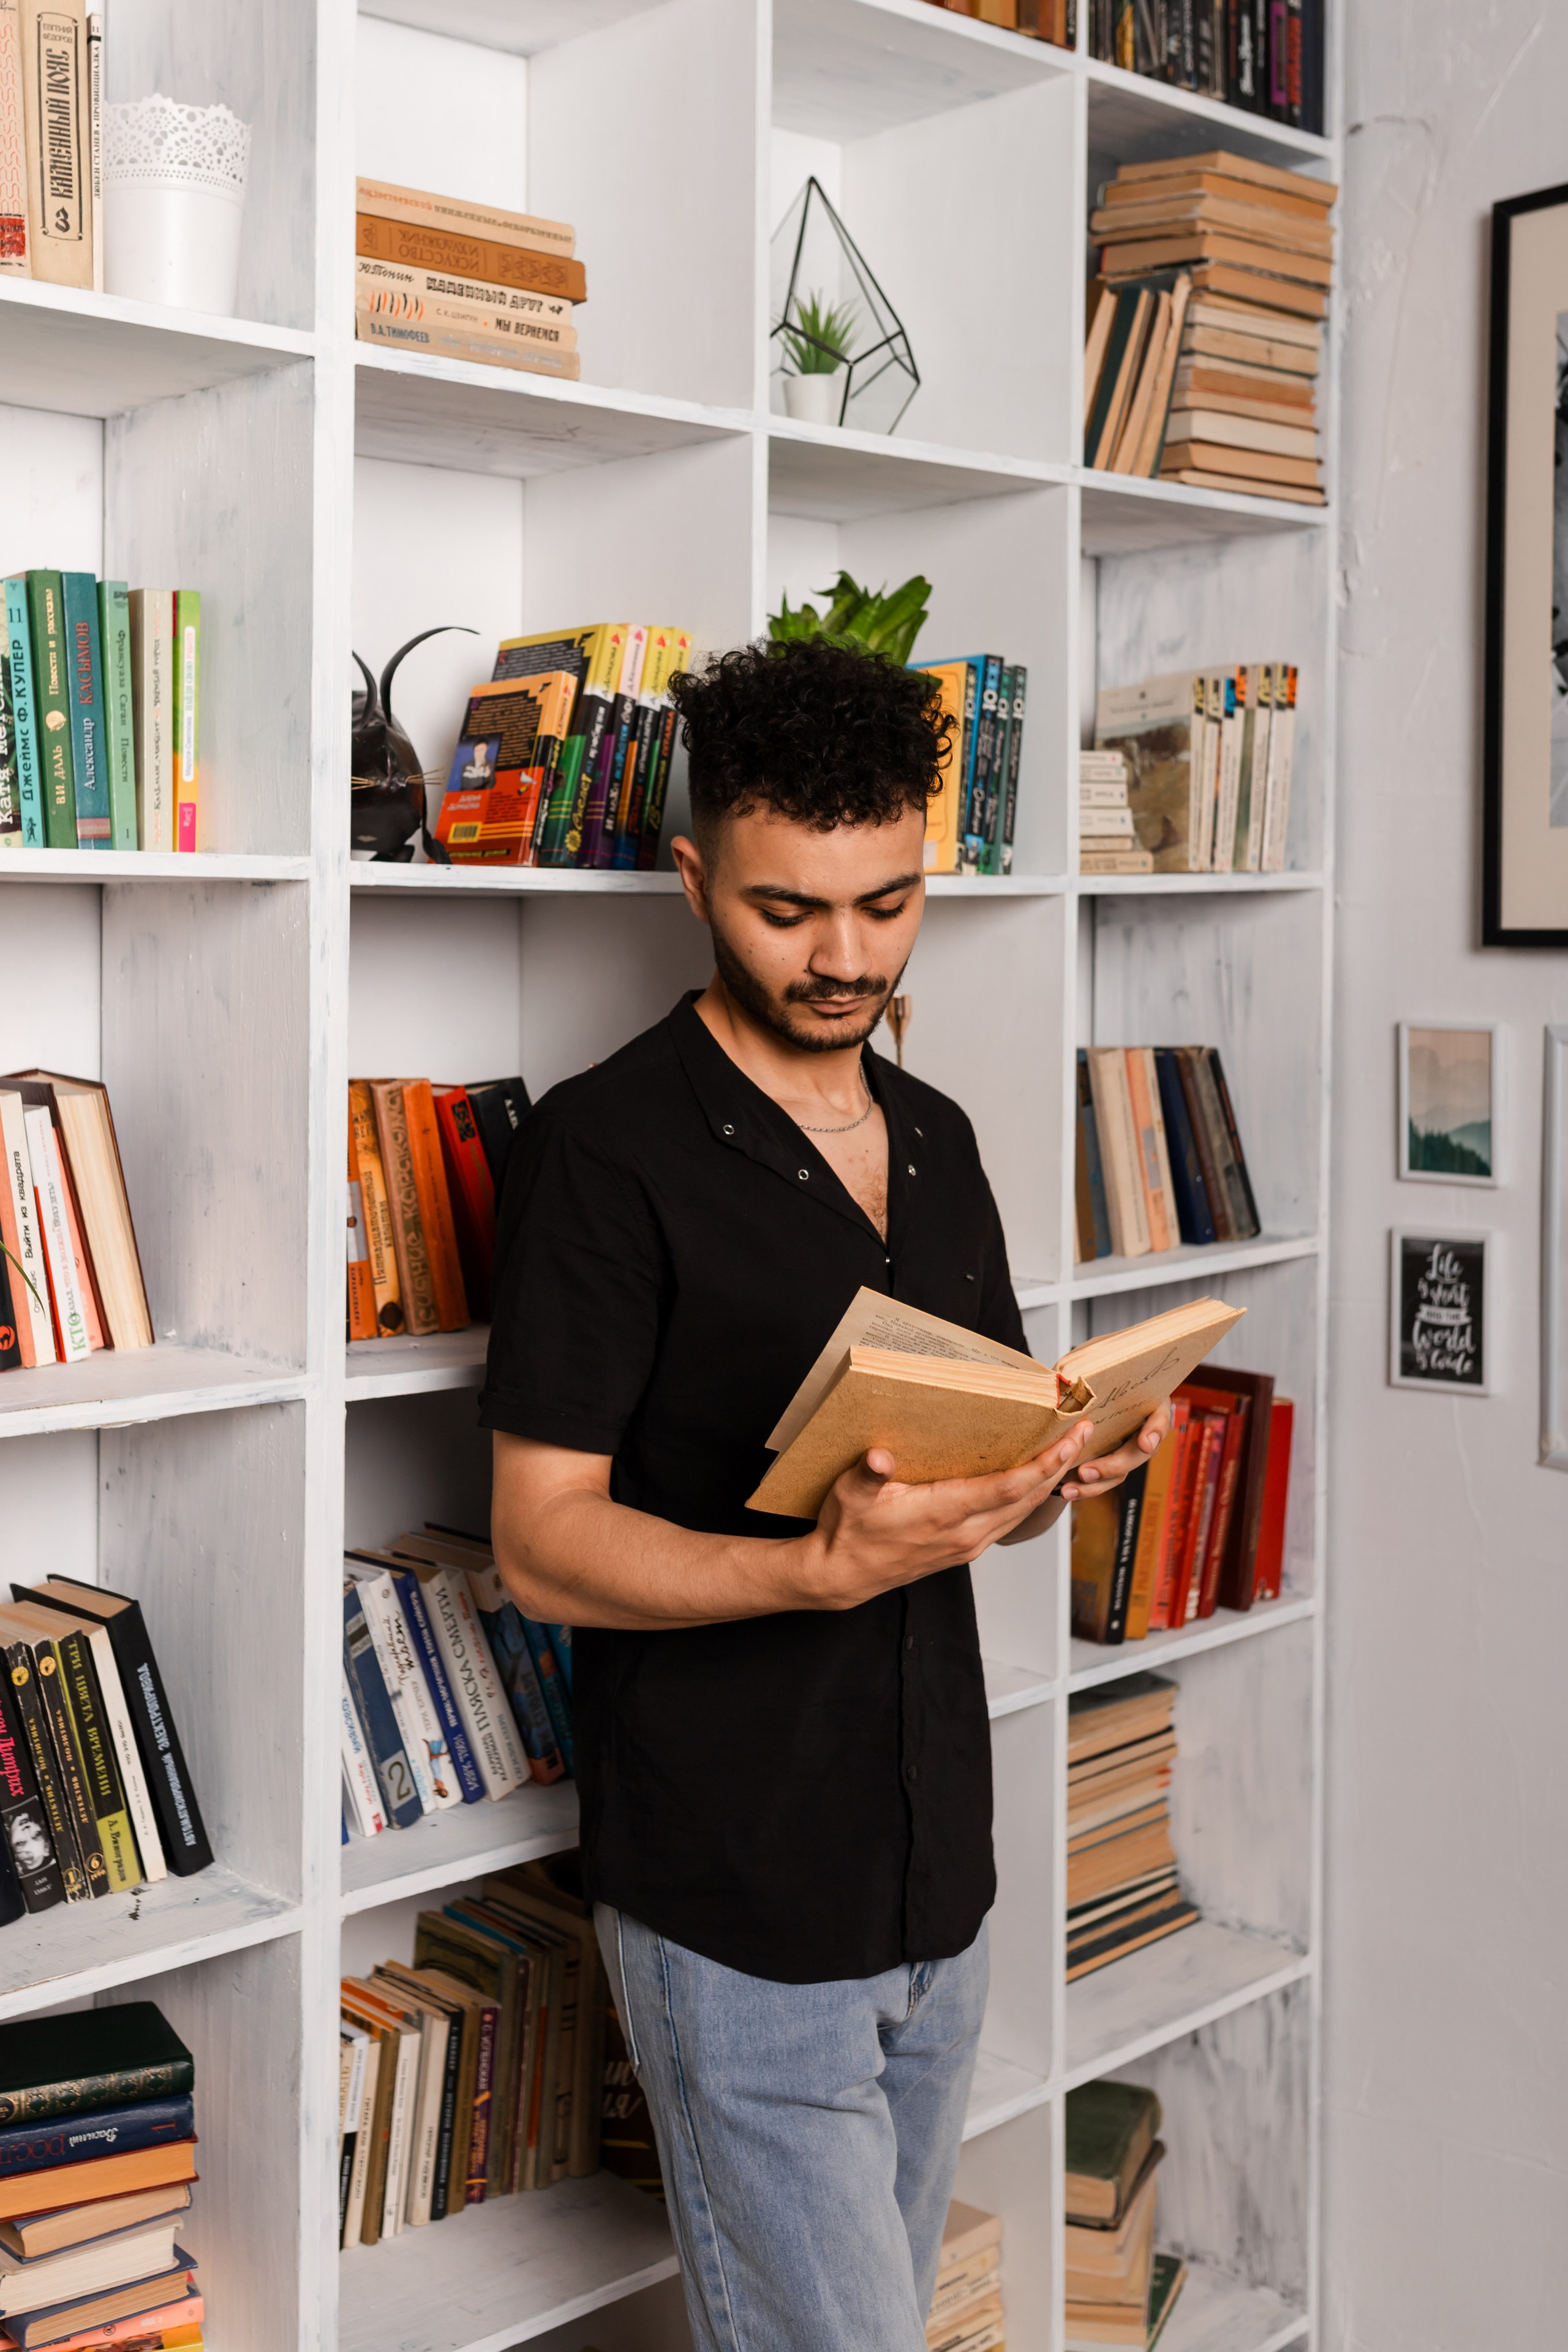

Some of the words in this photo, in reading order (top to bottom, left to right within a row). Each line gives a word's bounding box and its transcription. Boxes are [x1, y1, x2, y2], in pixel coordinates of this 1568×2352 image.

[46, 48, 71, 95] ПОЯС
[46, 97, 73, 199] КАМЕННЫЙ
[12, 639, 27, 698] КУПЕР
[75, 621, 93, 705] КАСЫМОВ
[20, 728, 34, 801] Джеймс
[53, 744, 66, 780] ДАЛЬ
[83, 717, 96, 791] Александр
[13, 1150, 26, 1201] квадрата
[20, 1206, 28, 1219] из
[24, 1224, 34, 1259] Выйти
[435, 1586, 466, 1659] СМЕРТИ
[68, 1639, 83, 1670] ТРИ
[75, 1674, 94, 1723] ЦВЕТА
[459, 1659, 491, 1732] ПЛЯСКА
[86, 1726, 112, 1796] ВРЕМЕНИ
[388, 1760, 411, 1801] 2
